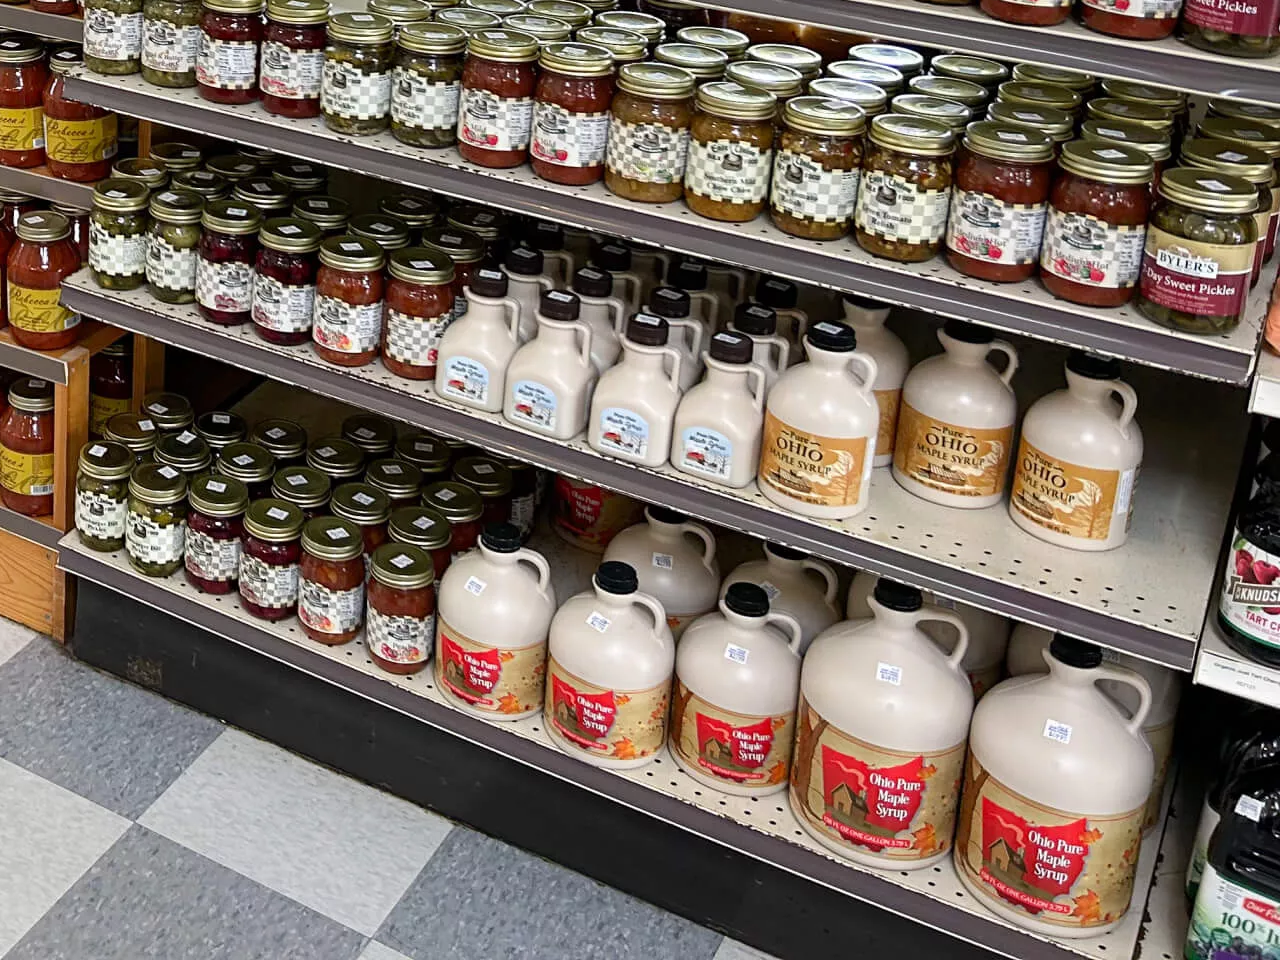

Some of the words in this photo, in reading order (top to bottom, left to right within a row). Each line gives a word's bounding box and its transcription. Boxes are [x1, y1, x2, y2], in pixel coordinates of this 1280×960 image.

[1218, 0, 1257, 14] Pickles
[1159, 252, 1215, 274] BYLER'S
[1165, 276, 1195, 292] Sweet
[1199, 285, 1235, 295] Pickles
[789, 430, 810, 444] Pure
[942, 426, 964, 438] Pure
[776, 437, 823, 462] OHIO
[926, 432, 978, 455] OHIO
[916, 442, 949, 461] MAPLE
[951, 453, 985, 468] SYRUP
[1035, 454, 1054, 469] Pure
[797, 460, 831, 476] SYRUP
[1023, 458, 1067, 489] OHIO
[1040, 484, 1076, 503] SYRUP
[1246, 611, 1267, 626] TART
[463, 653, 479, 667] Ohio
[480, 659, 498, 670] Pure
[470, 666, 491, 678] Maple
[470, 674, 493, 689] Syrup
[577, 695, 594, 710] Ohio
[595, 701, 613, 713] Pure
[583, 708, 605, 721] Maple
[582, 717, 608, 733] Syrup
[732, 730, 751, 740] Ohio
[753, 732, 771, 741] Pure
[739, 741, 763, 751] Maple
[738, 750, 765, 762] Syrup
[870, 773, 896, 789] Ohio
[897, 777, 921, 791] Pure
[877, 790, 910, 805] Maple
[876, 803, 908, 820] Syrup
[849, 829, 864, 839] ONE
[864, 834, 889, 845] GALLON
[1028, 830, 1055, 851] Ohio
[1057, 838, 1084, 855] Pure
[1037, 849, 1071, 868] Maple
[1034, 863, 1068, 885] Syrup
[1006, 888, 1020, 898] ONE
[1020, 893, 1048, 908] GALLON
[1221, 912, 1265, 933] 100%
